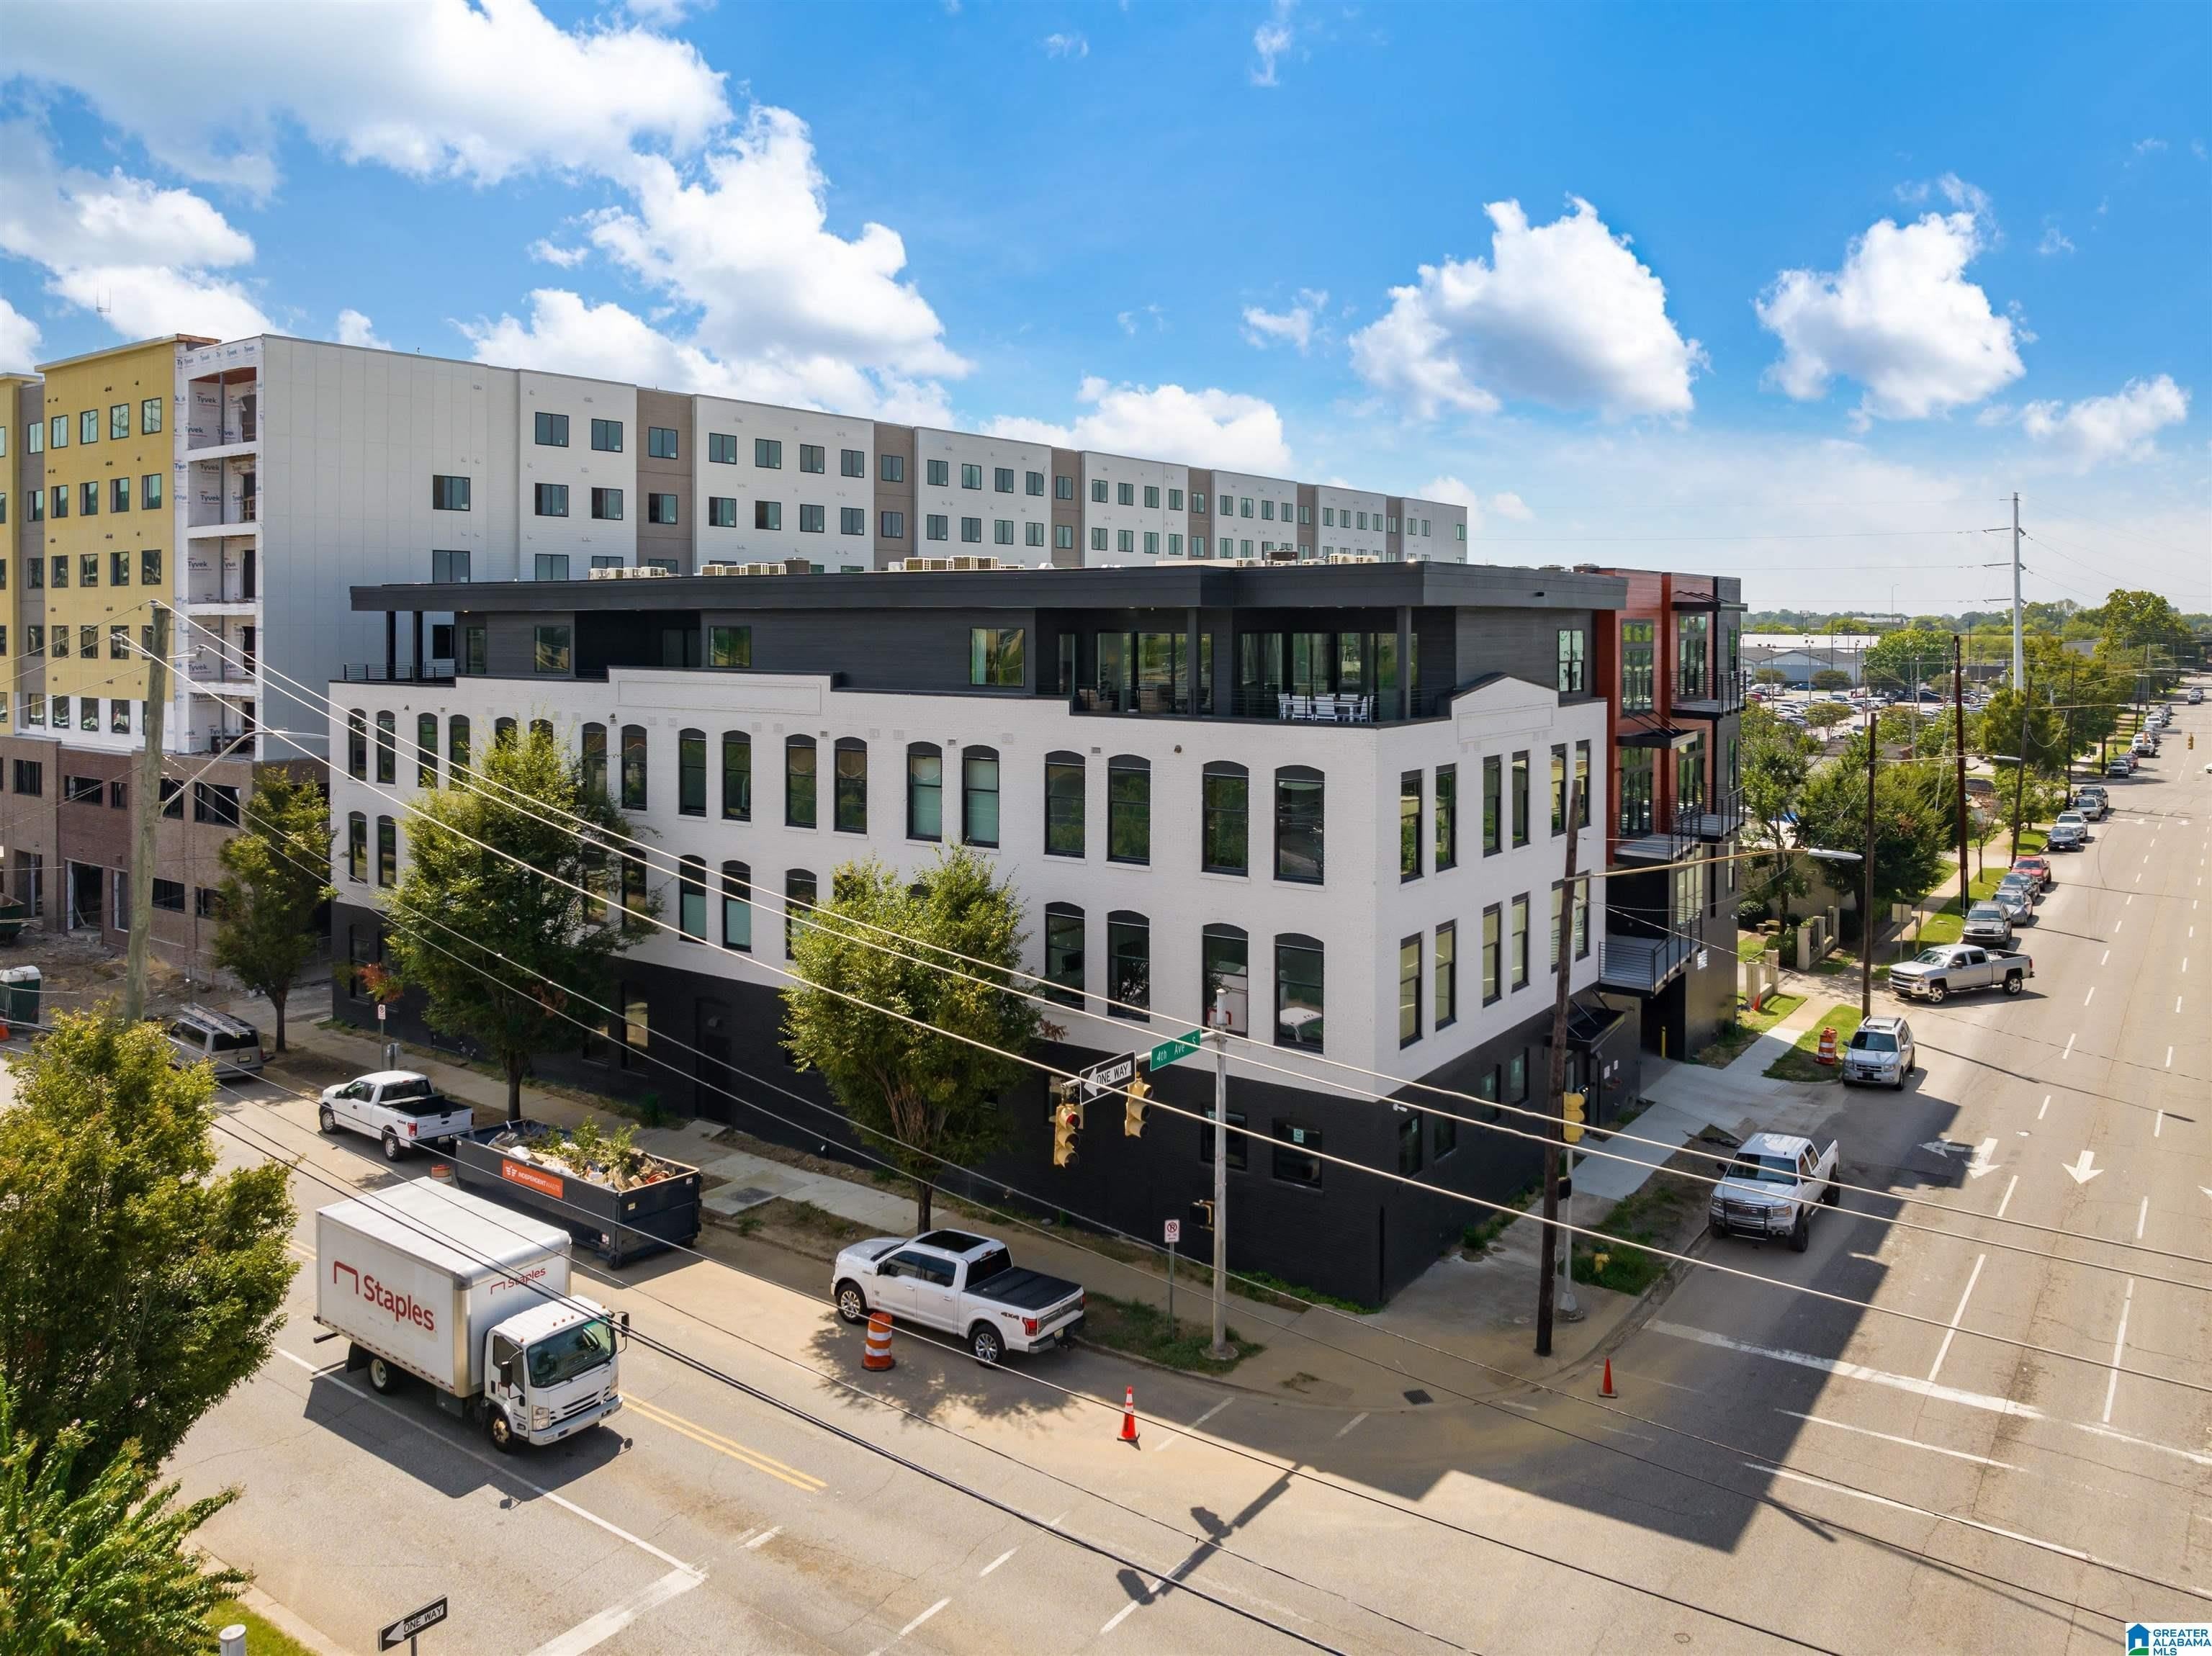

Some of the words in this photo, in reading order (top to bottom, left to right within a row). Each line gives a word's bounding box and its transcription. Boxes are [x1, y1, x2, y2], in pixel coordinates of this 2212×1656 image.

[1157, 1050, 1167, 1062] 4th
[1174, 1044, 1185, 1056] Ave
[1192, 1036, 1197, 1045] S
[1097, 1071, 1110, 1084] ONE
[1114, 1063, 1128, 1079] WAY
[508, 1268, 546, 1288] Staples
[364, 1275, 434, 1331] Staples
[403, 1617, 421, 1633] ONE
[424, 1606, 443, 1623] WAY
